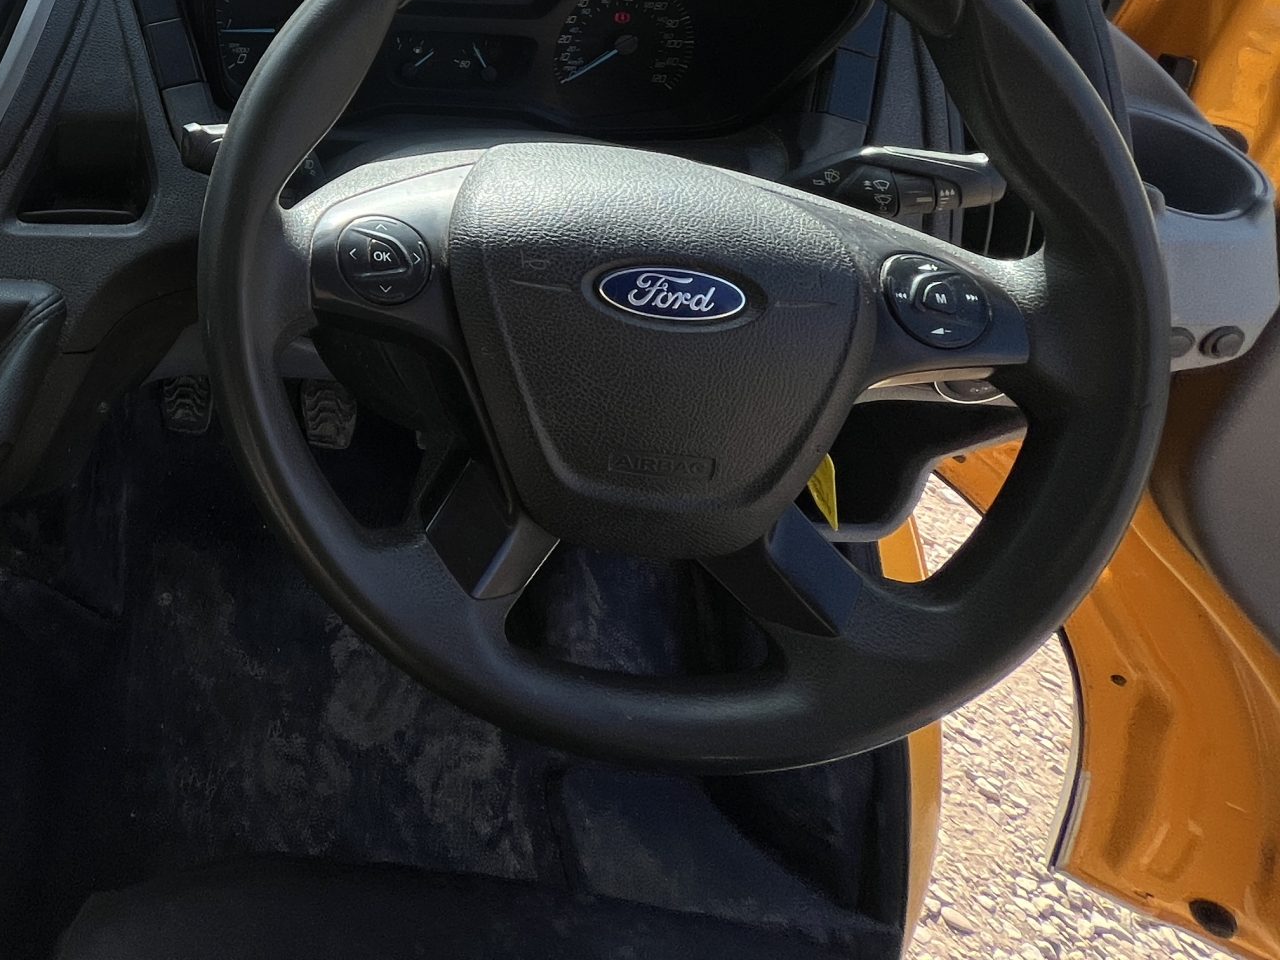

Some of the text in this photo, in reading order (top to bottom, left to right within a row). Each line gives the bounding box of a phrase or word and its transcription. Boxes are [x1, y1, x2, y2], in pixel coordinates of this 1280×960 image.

[558, 35, 573, 44] 20
[237, 54, 247, 64] 0
[373, 251, 392, 263] OK
[627, 272, 716, 312] Ford
[935, 293, 948, 304] M
[614, 454, 706, 474] AIRBAG
